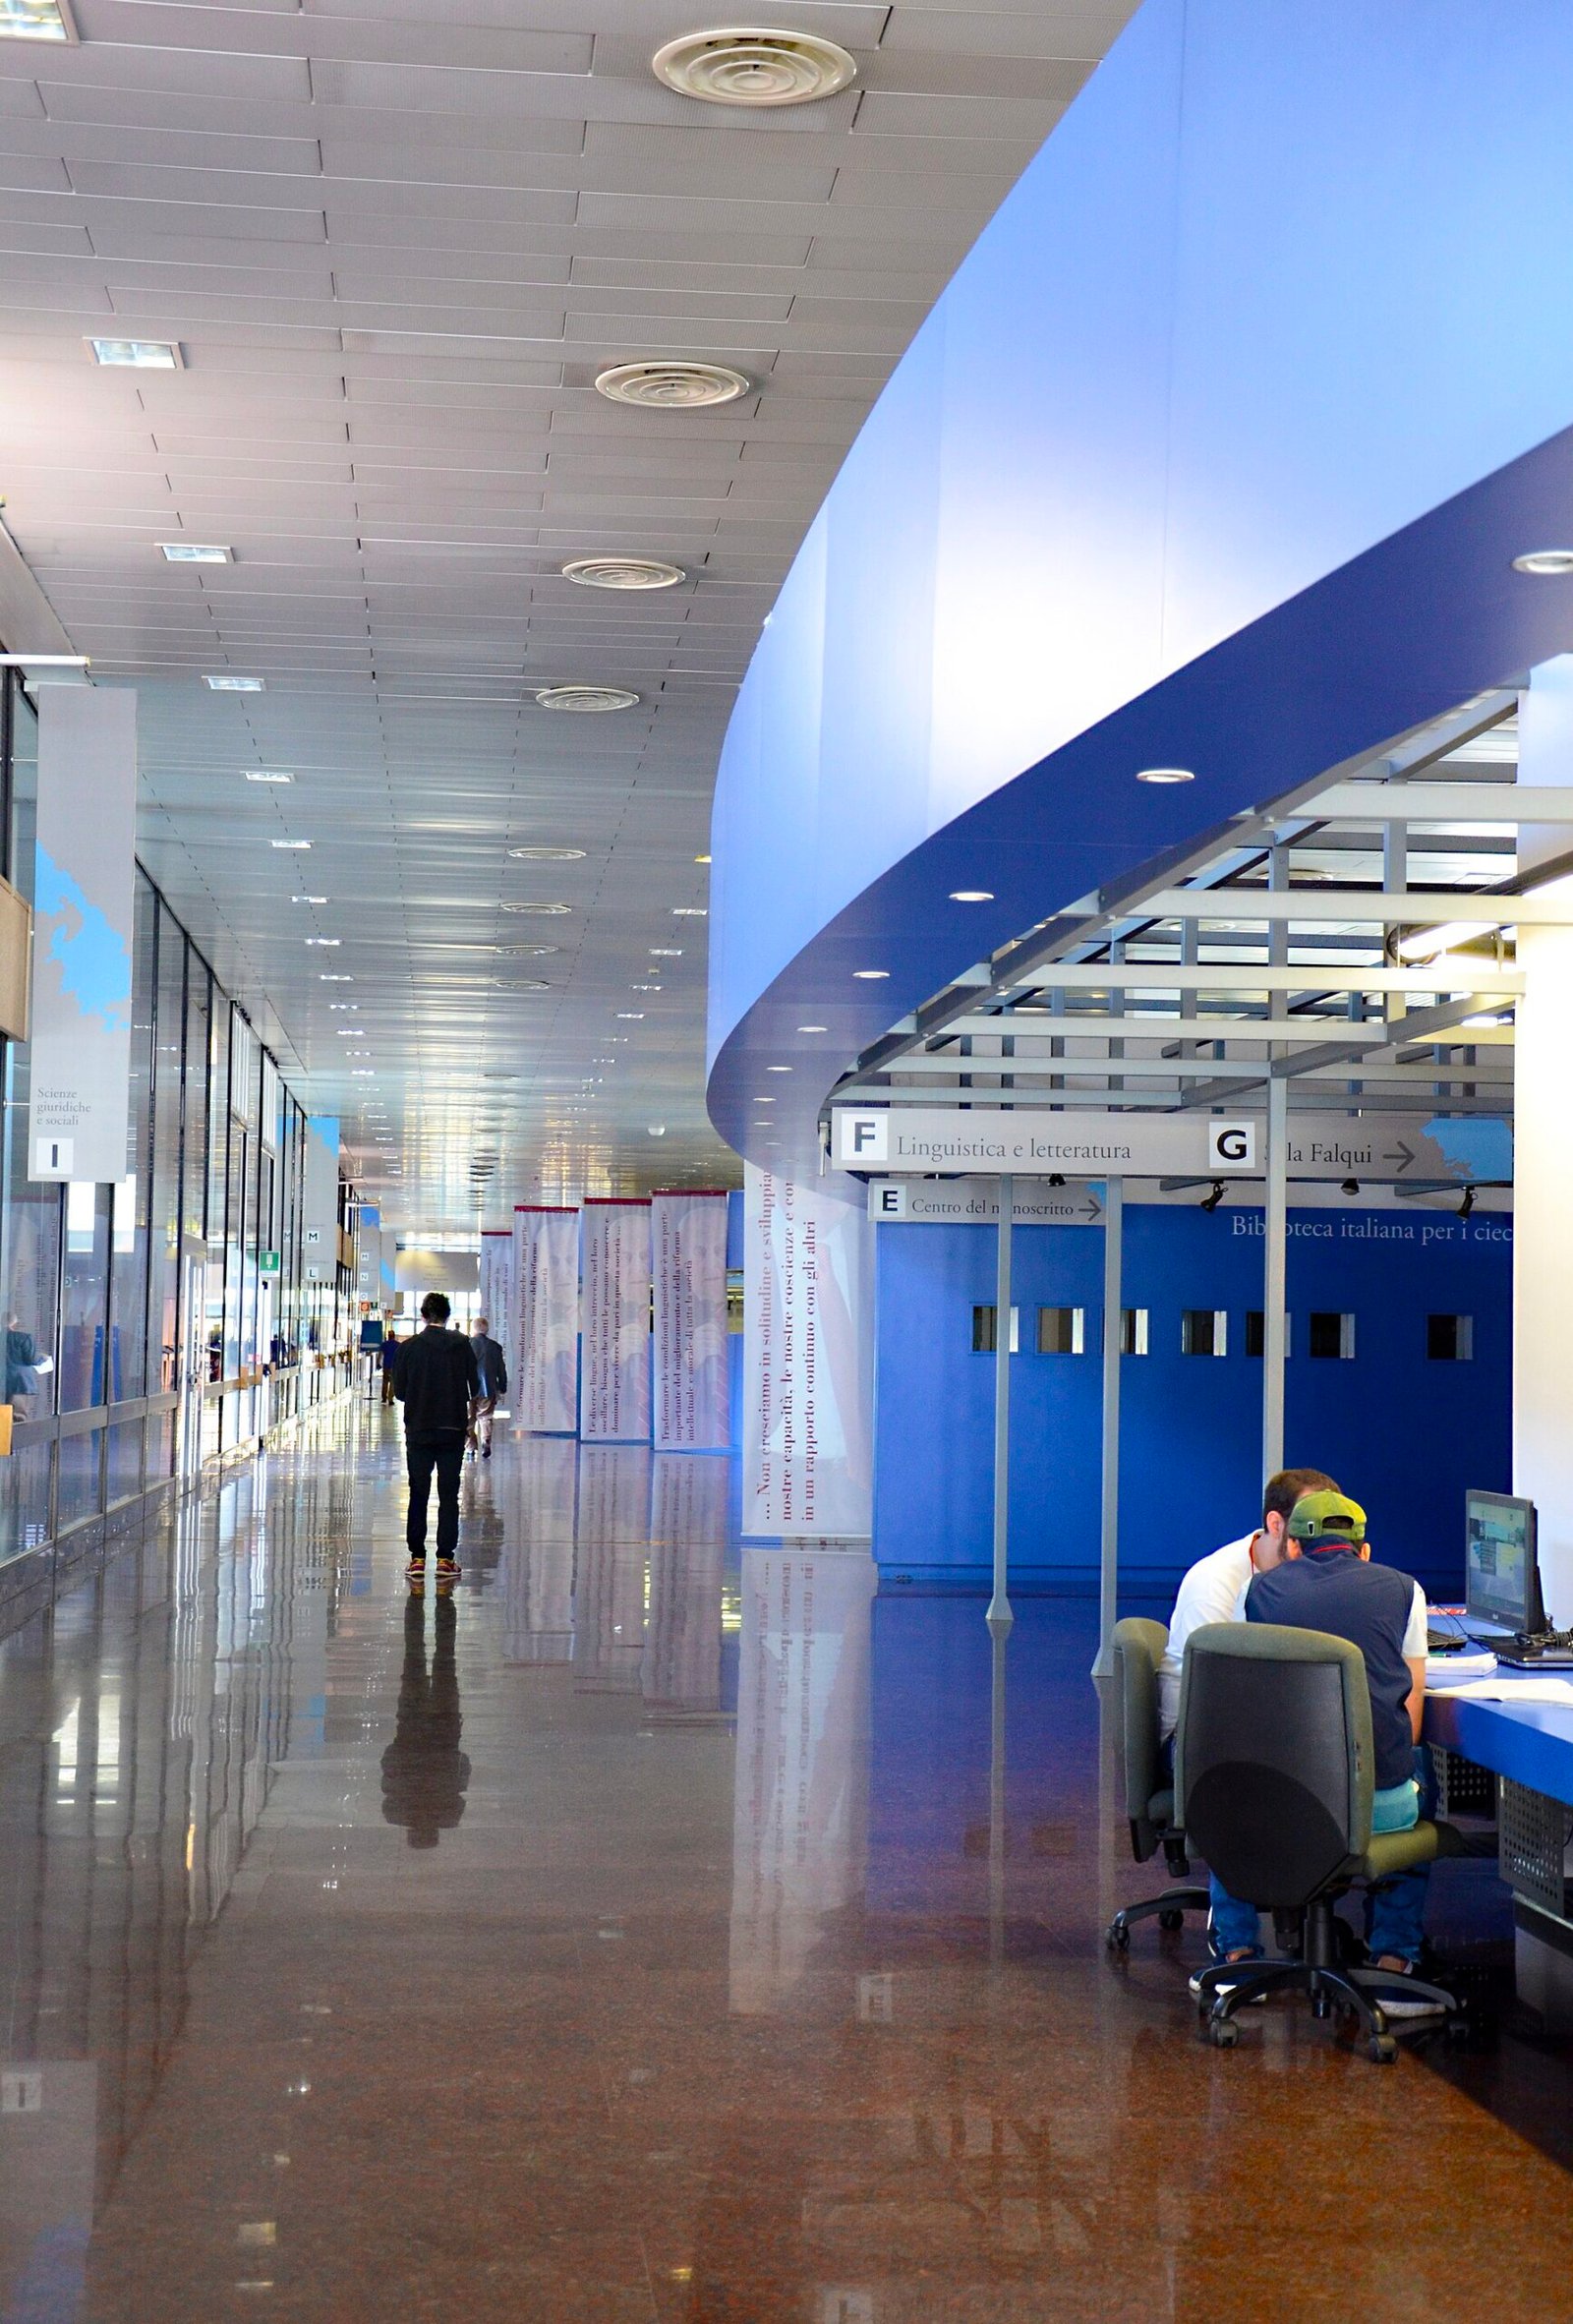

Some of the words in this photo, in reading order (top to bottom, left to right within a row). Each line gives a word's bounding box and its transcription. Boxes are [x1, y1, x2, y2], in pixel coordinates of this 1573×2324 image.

[37, 1087, 78, 1098] Scienze
[36, 1101, 91, 1114] giuridiche
[45, 1115, 79, 1126] sociali
[854, 1122, 875, 1152] F
[898, 1135, 1005, 1162] Linguistica
[1013, 1144, 1023, 1158] e
[1030, 1138, 1131, 1159] letteratura
[1217, 1130, 1247, 1160] G
[52, 1143, 58, 1168] I
[1311, 1143, 1371, 1171] Falqui
[758, 1171, 775, 1246] sviluppia
[882, 1191, 899, 1211] E
[912, 1198, 961, 1215] Centro
[965, 1199, 986, 1214] del
[991, 1200, 1074, 1215] mnoscritto
[802, 1221, 815, 1254] altri
[1232, 1215, 1332, 1238] Biboteca
[1342, 1217, 1415, 1239] italiana
[1422, 1226, 1454, 1246] per
[1474, 1222, 1513, 1241] ciec
[763, 1251, 771, 1260] e
[782, 1228, 793, 1305] coscienze
[802, 1261, 818, 1280] gli
[758, 1266, 771, 1345] solitudine
[805, 1287, 815, 1315] con
[612, 1332, 619, 1342] da
[673, 1304, 682, 1370] miglioramento
[783, 1311, 792, 1362] nostre
[759, 1353, 771, 1366] in
[802, 1322, 815, 1393] continuo
[781, 1369, 792, 1382] le
[589, 1422, 596, 1432] Le
[674, 1390, 683, 1441] importante
[759, 1373, 771, 1455] cresciamo
[780, 1390, 795, 1463] capacità,
[804, 1400, 817, 1473] rapporto
[757, 1463, 771, 1495] Non
[805, 1480, 814, 1499] un
[782, 1470, 792, 1520] nostre
[802, 1506, 814, 1521] in
